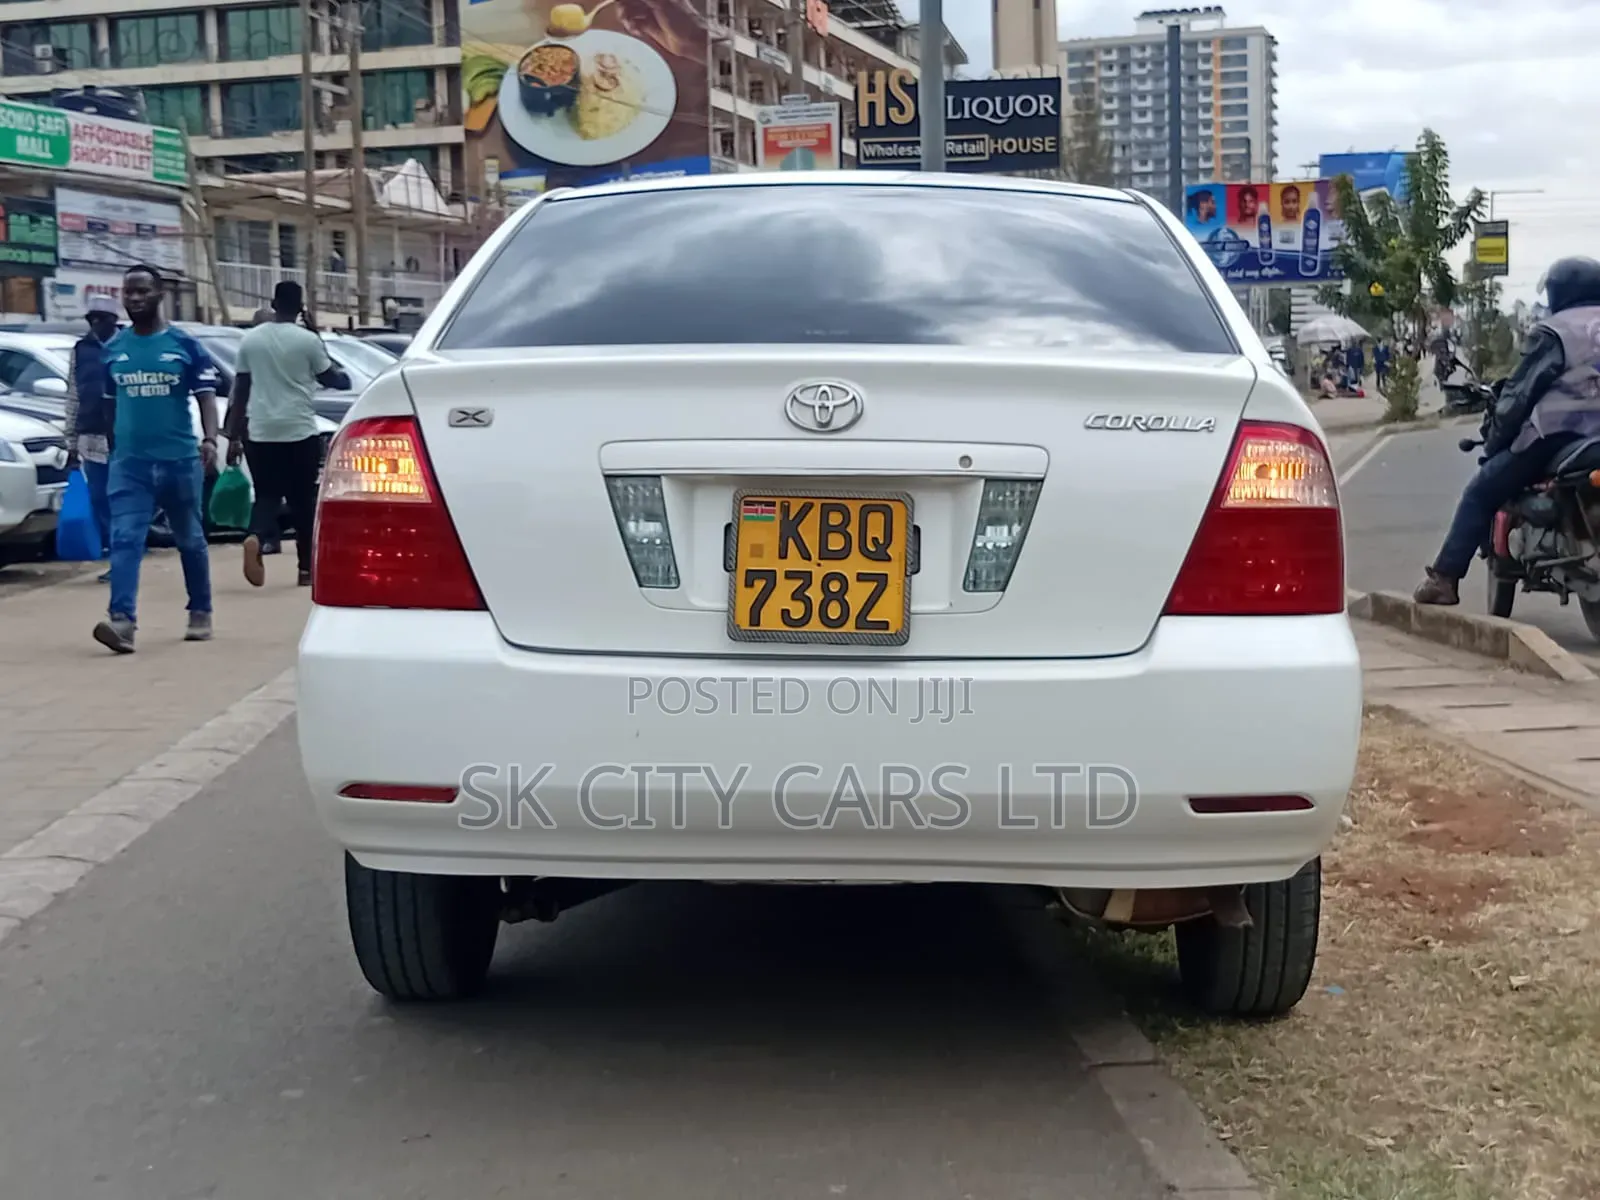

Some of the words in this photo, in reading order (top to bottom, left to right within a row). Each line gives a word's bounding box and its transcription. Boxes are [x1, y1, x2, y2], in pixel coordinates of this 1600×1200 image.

[857, 69, 920, 127] HS
[946, 94, 1057, 124] LIQUOR
[16, 134, 54, 159] MALL
[72, 122, 153, 152] AFFORDABLE
[864, 143, 921, 158] Wholesa
[946, 140, 985, 155] Retail
[990, 136, 1057, 154] HOUSE
[72, 144, 112, 167] SHOPS
[114, 150, 130, 169] TO
[132, 155, 152, 171] LET
[1084, 412, 1216, 432] COROLLA
[778, 501, 893, 562] KBQ
[744, 569, 889, 630] 738Z
